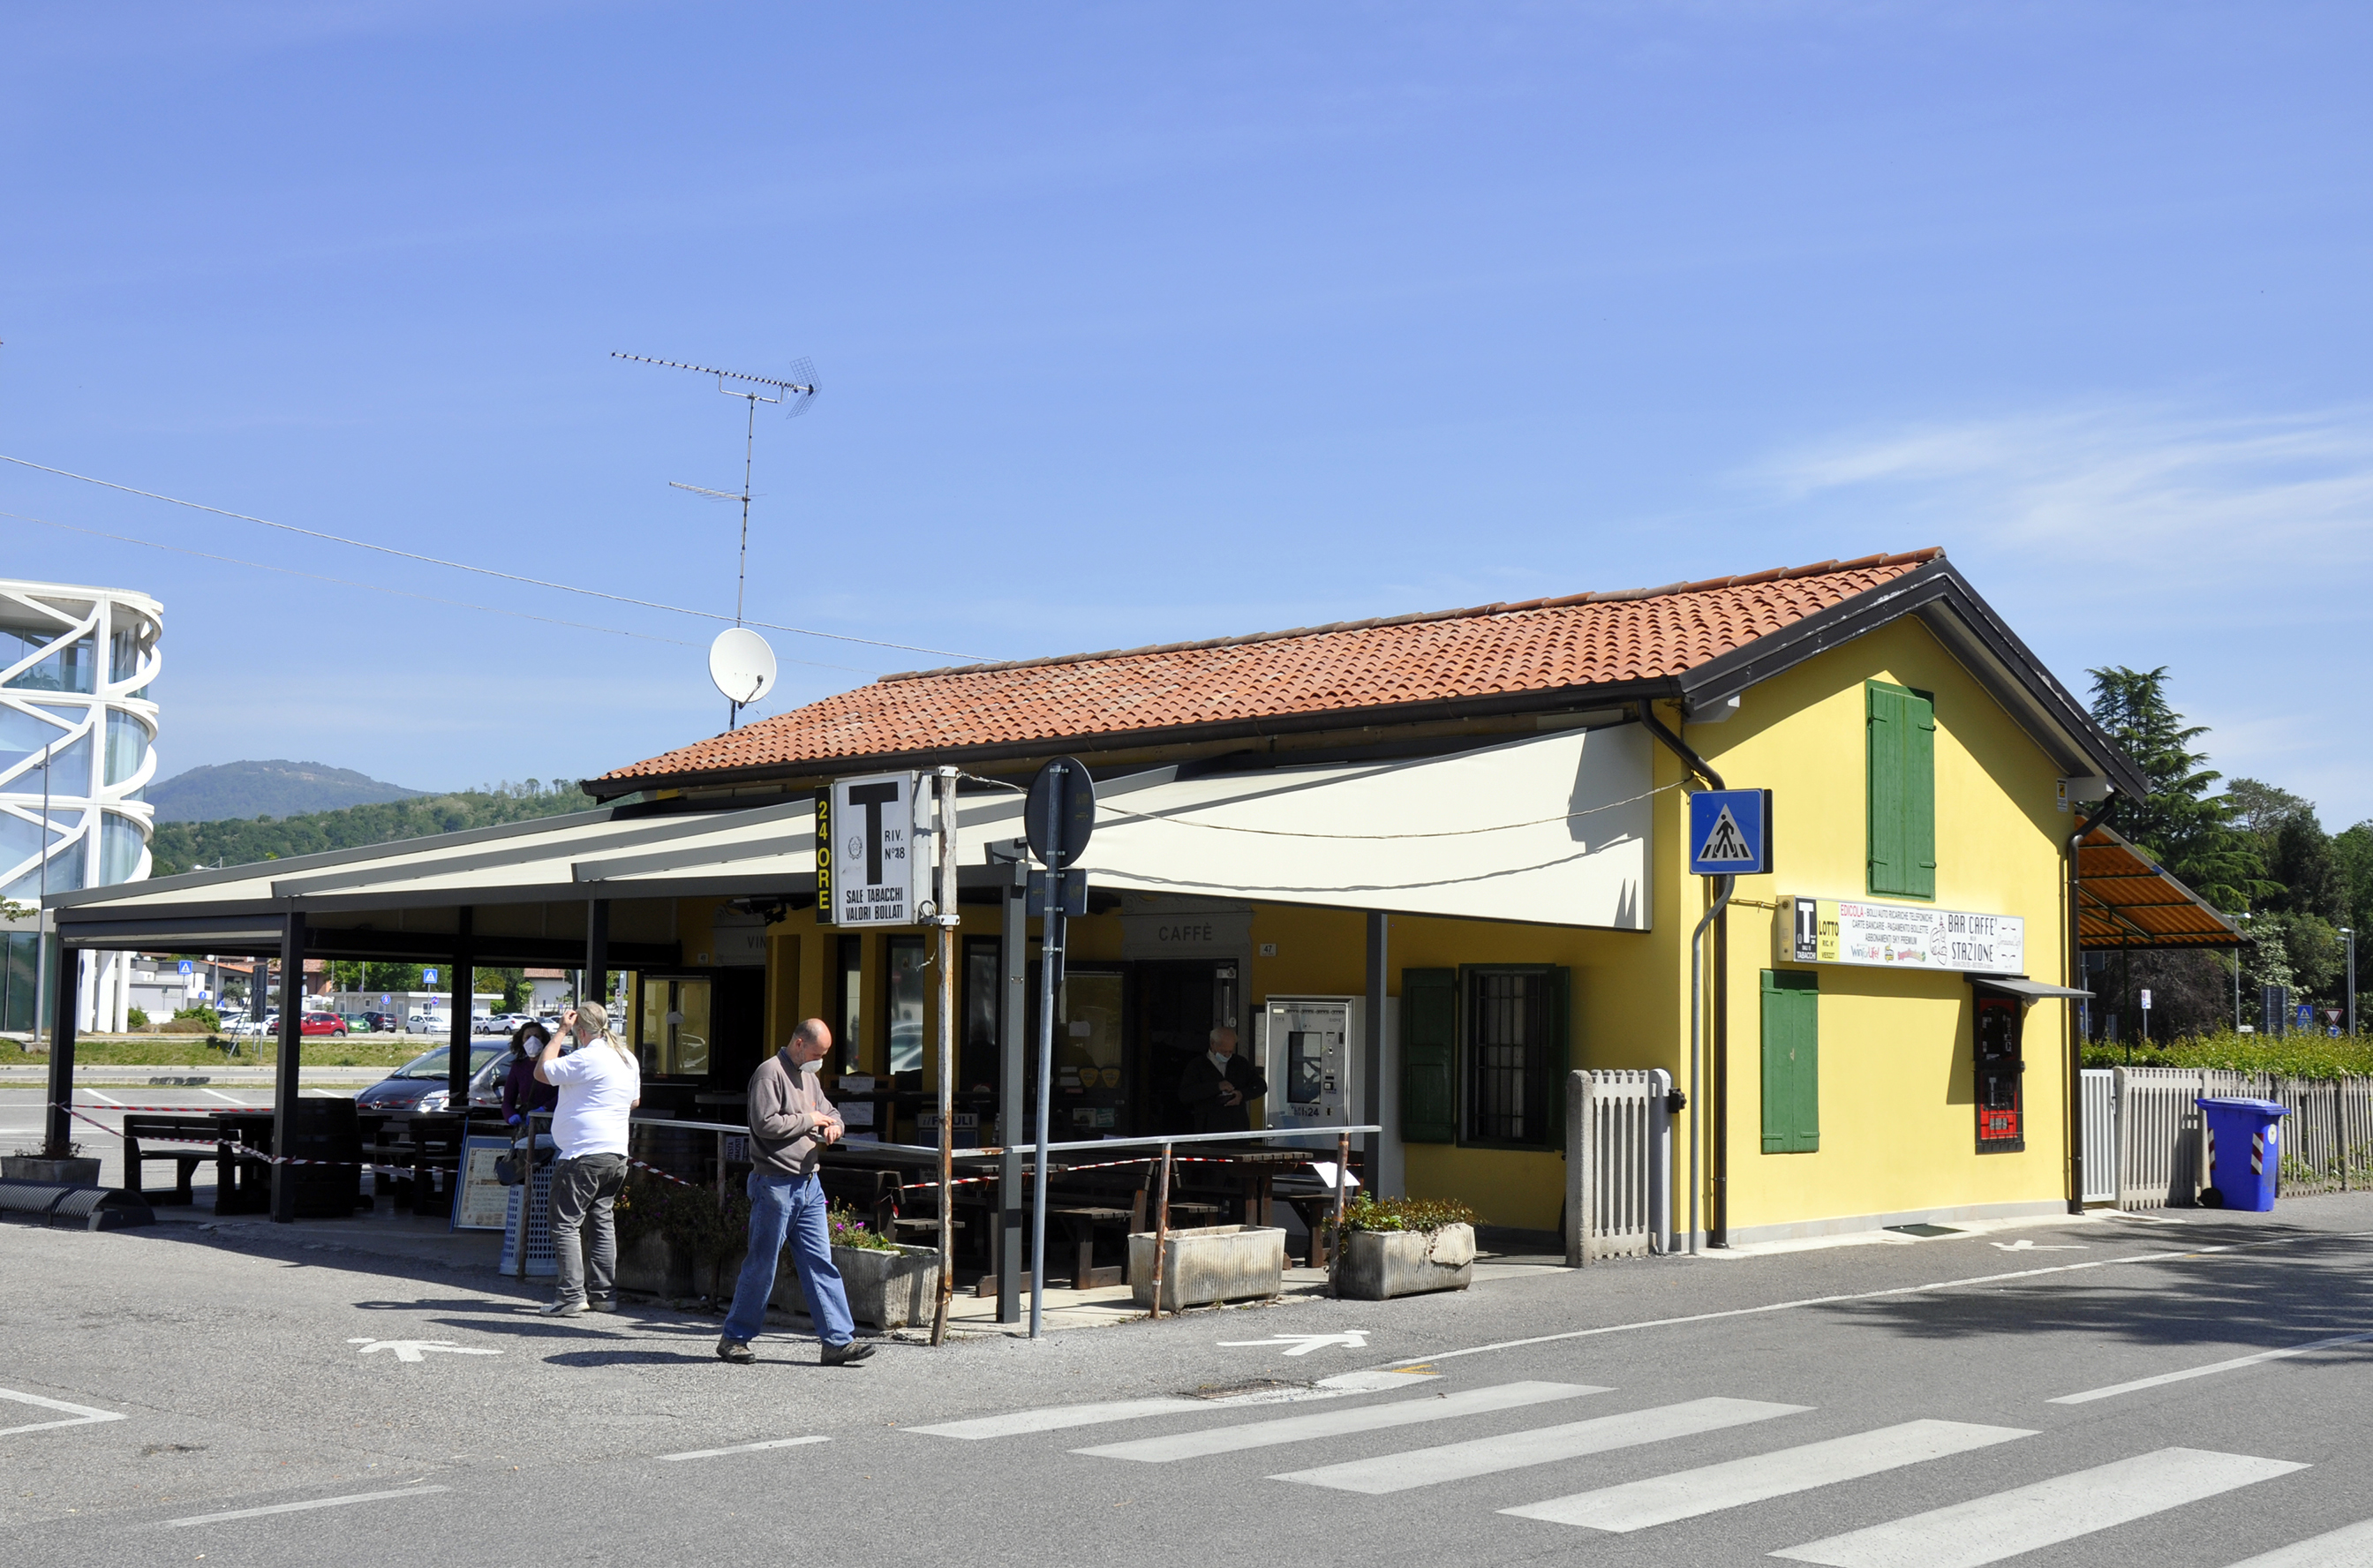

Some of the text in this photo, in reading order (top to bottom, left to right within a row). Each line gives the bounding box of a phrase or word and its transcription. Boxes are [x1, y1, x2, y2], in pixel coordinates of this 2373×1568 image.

[848, 780, 899, 886] T
[885, 829, 904, 842] RIV.
[817, 800, 830, 909] 24 ORE
[846, 886, 903, 904] SALE TABACCHI
[845, 903, 903, 922] VALORI BOLLATI
[1840, 904, 1864, 918] EDICOLA
[1158, 922, 1212, 941] CAFFÈ
[1798, 901, 1814, 944] T
[1818, 920, 1840, 937] LOTTO
[1851, 919, 1865, 929] CARTE
[1865, 920, 1885, 931] BANCARIE
[1887, 922, 1910, 932] PAGAMENTO
[1910, 923, 1929, 934] BOLLETTE
[1947, 914, 1998, 936] BAR CAFFE'
[1865, 932, 1892, 944] ABBONAMENTI
[1900, 936, 1917, 945] PREMIUM
[1263, 945, 1272, 954] 47
[1951, 941, 1994, 962] STAZIONE
